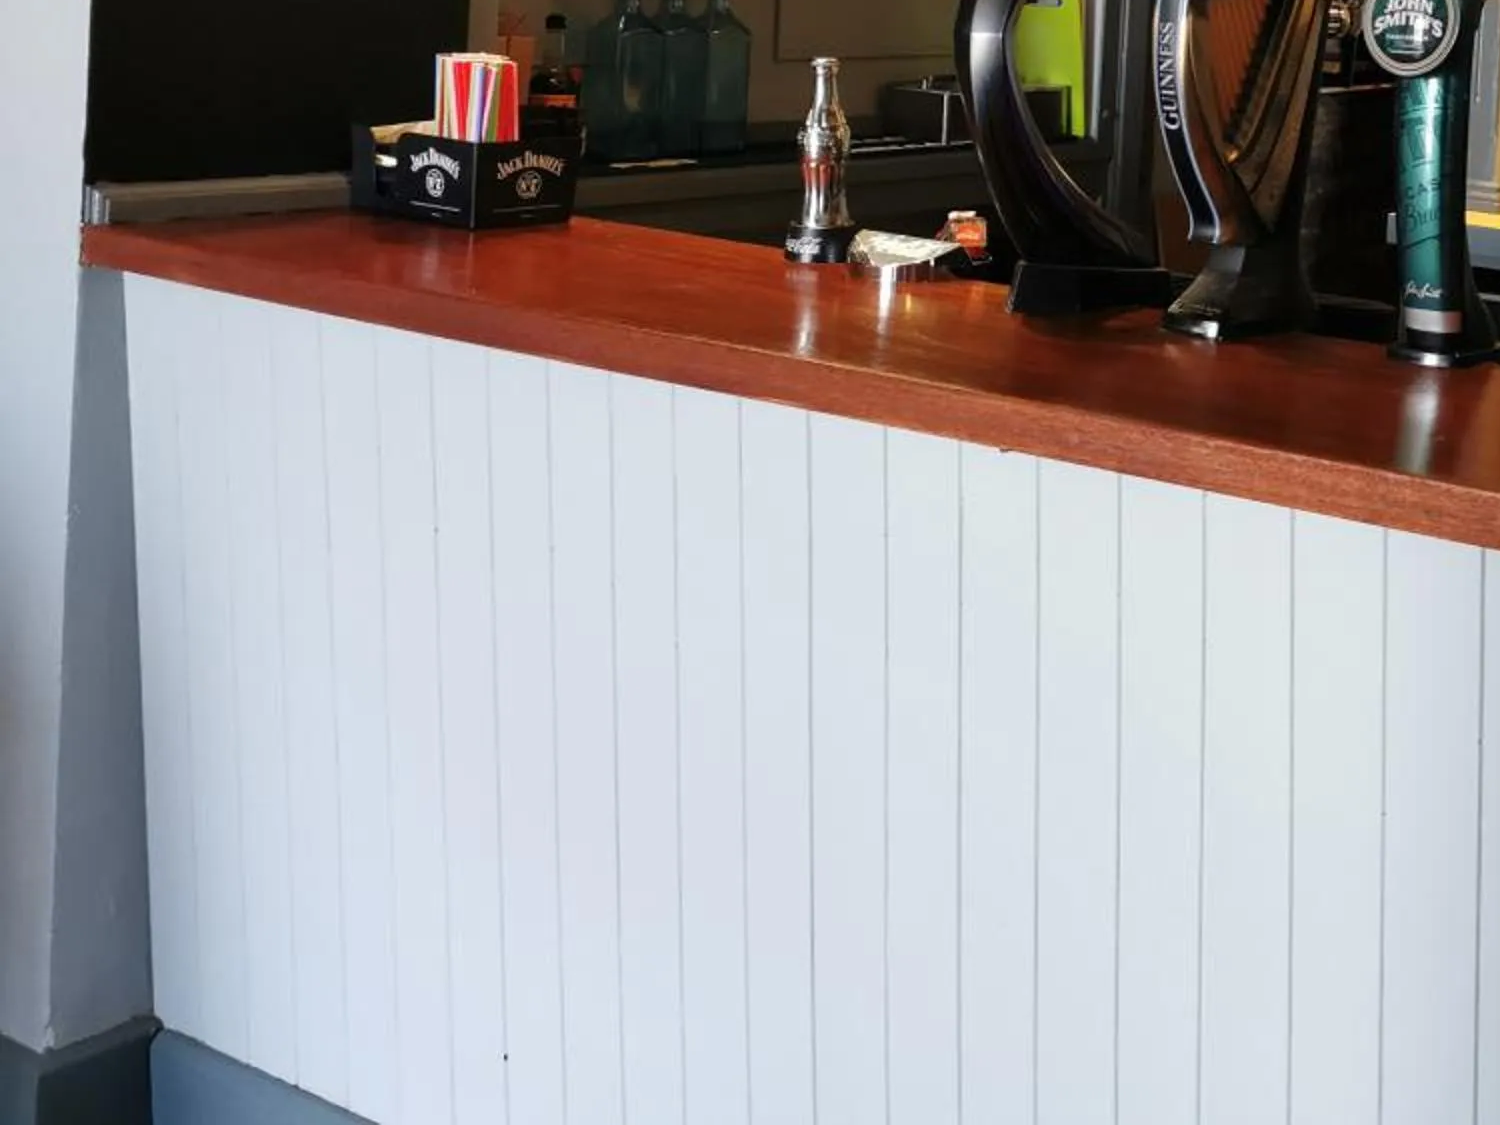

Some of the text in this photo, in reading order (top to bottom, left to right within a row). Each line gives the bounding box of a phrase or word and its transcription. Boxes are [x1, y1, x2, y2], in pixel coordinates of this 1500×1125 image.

[1373, 11, 1443, 38] SMITH'S
[1159, 21, 1181, 131] GUINNESS
[410, 154, 429, 172] JACK
[497, 159, 525, 180] JACK
